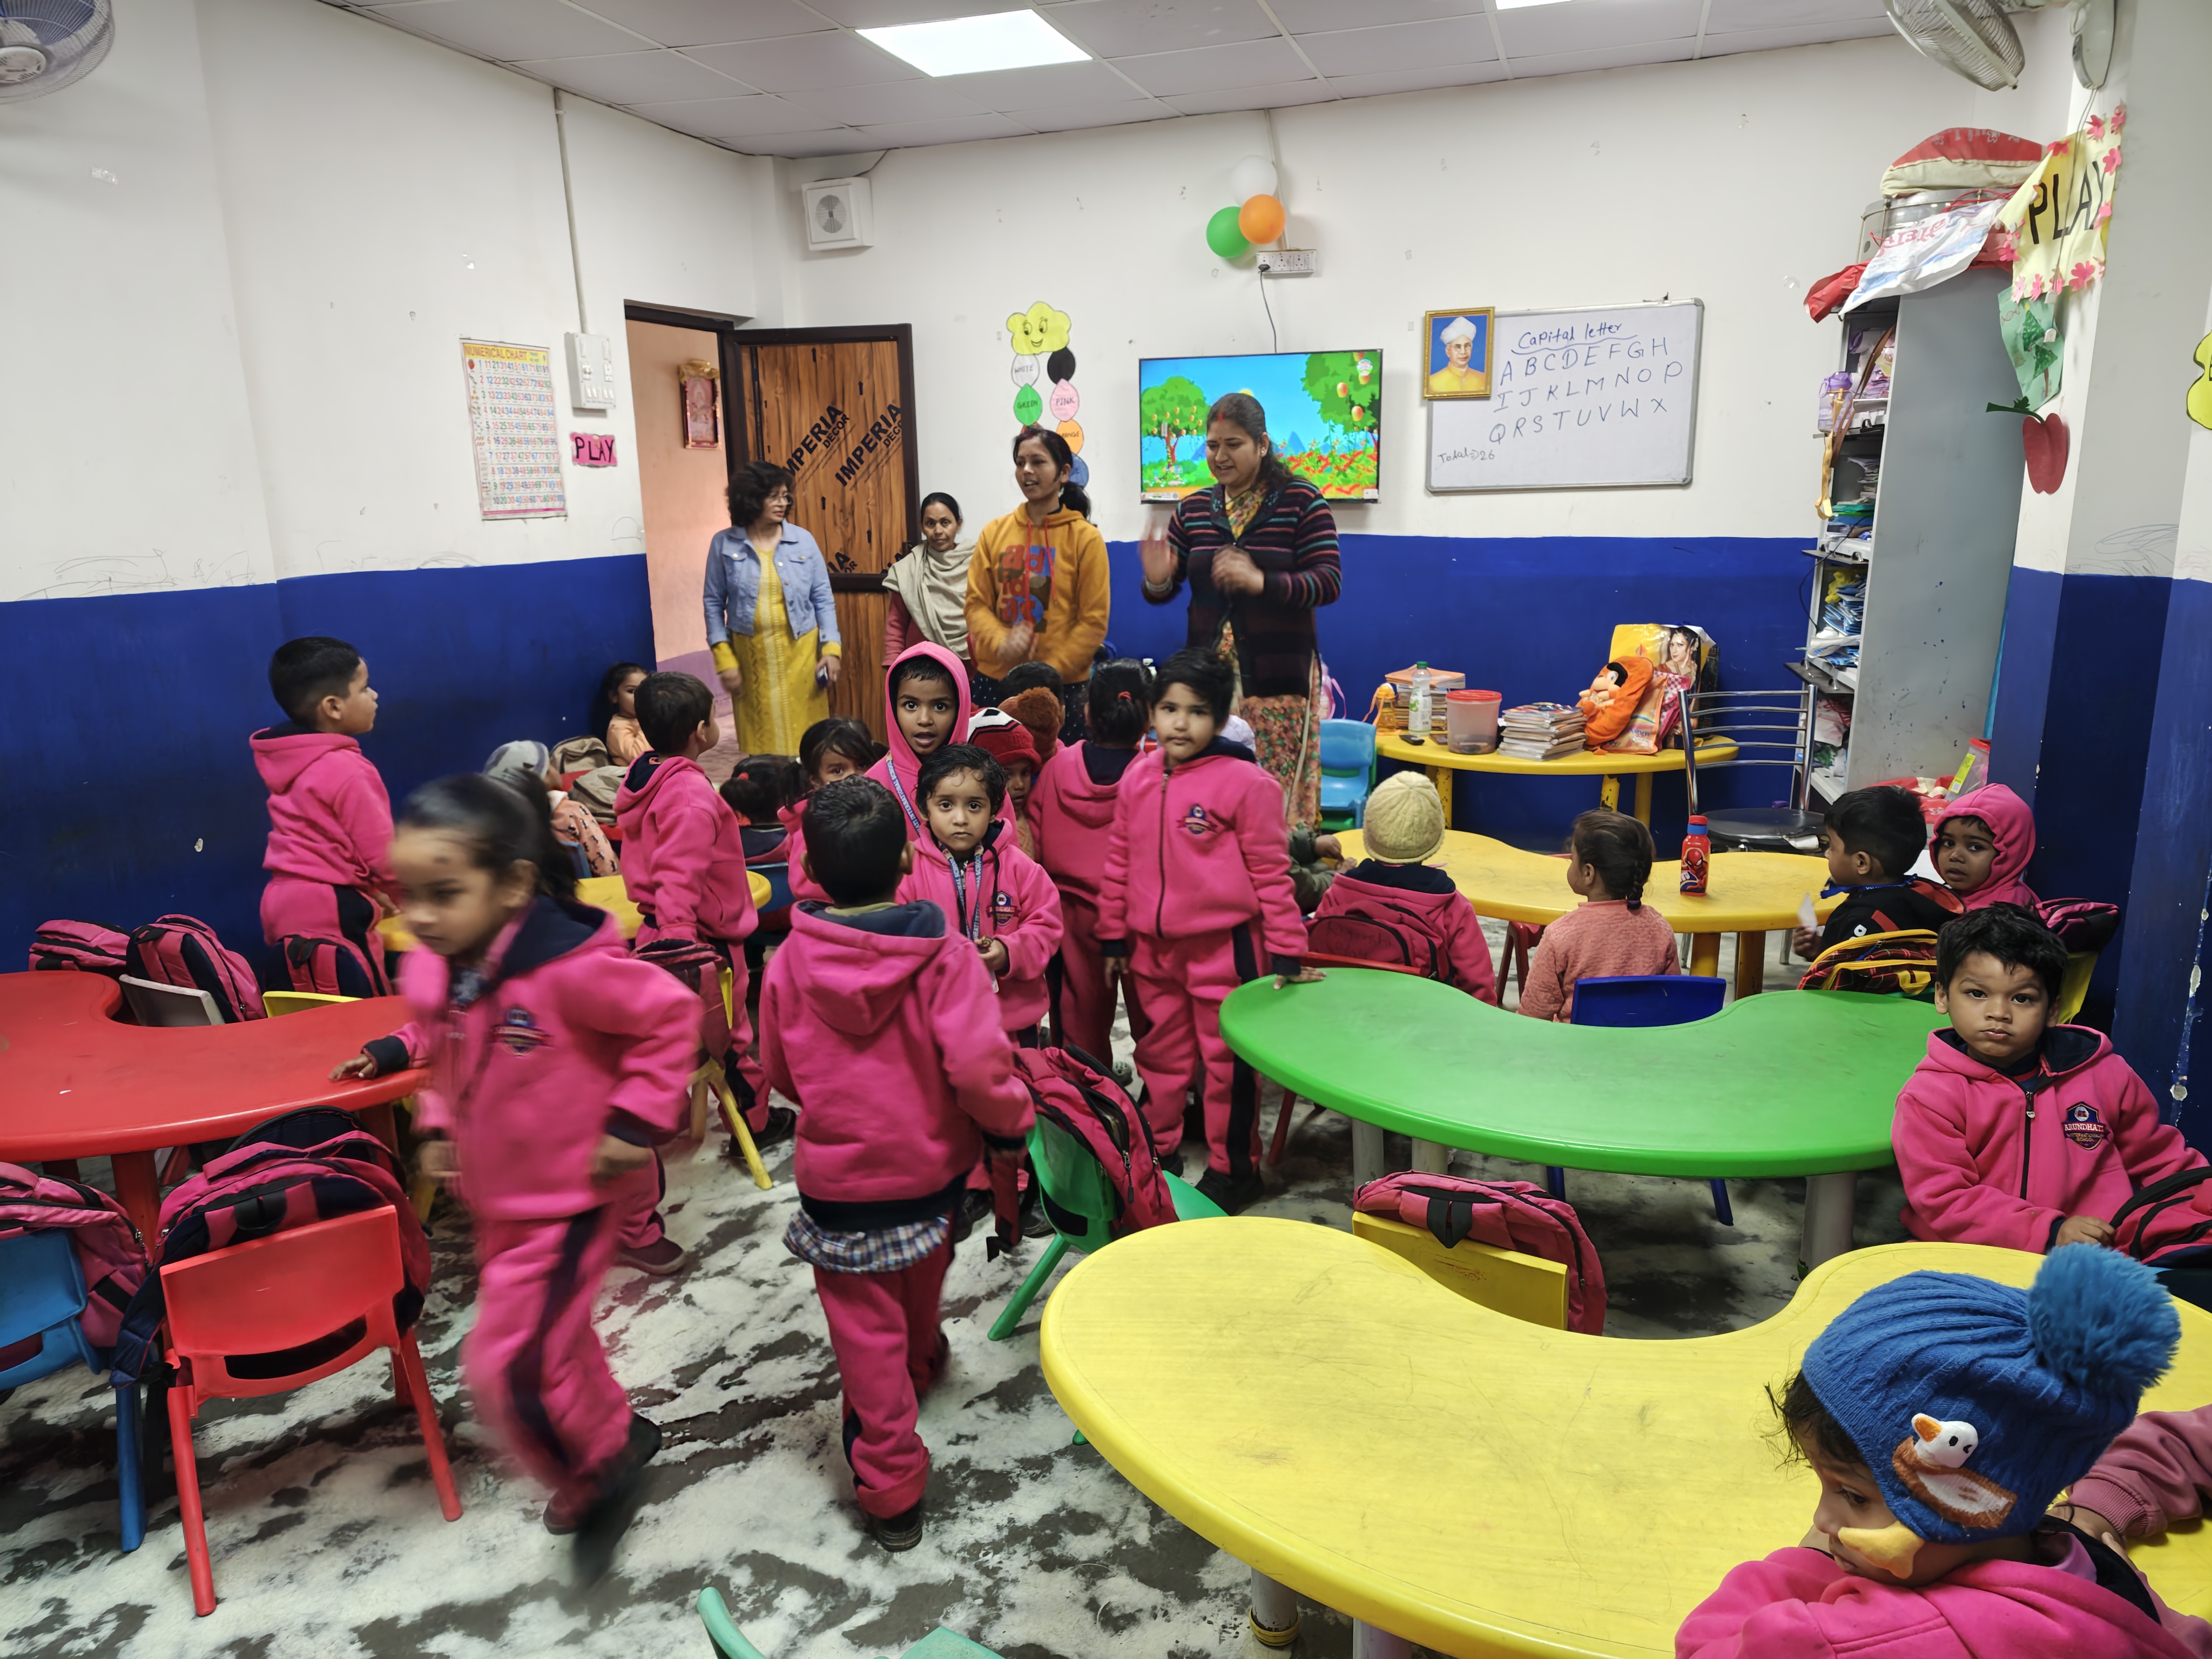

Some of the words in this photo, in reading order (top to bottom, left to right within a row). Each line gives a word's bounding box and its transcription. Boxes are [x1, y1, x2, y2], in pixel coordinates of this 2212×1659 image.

[2028, 161, 2106, 245] PLAY
[1518, 326, 1575, 349] Capital
[1585, 323, 1622, 338] letter
[464, 346, 505, 359] NUMERICAL
[505, 349, 527, 361] CHART
[1500, 361, 1513, 386] A
[1525, 358, 1537, 377] B
[1544, 353, 1556, 371] C
[1562, 348, 1578, 370] D
[1584, 346, 1601, 367] E
[1609, 343, 1622, 360] F
[1628, 341, 1644, 359] G
[1651, 336, 1668, 357] H
[492, 361, 499, 369] 21
[1014, 364, 1034, 374] WHITE
[480, 375, 483, 383] 2
[486, 376, 493, 384] 12
[494, 376, 501, 385] 22
[1493, 390, 1513, 413] I
[1520, 387, 1539, 408] J
[1547, 385, 1559, 402] K
[1566, 381, 1580, 396] L
[1586, 377, 1605, 395] M
[1615, 367, 1629, 388] N
[1637, 368, 1651, 382] O
[1665, 361, 1683, 383] P
[481, 390, 485, 399] 3
[1016, 400, 1038, 409] GREEN
[1056, 397, 1075, 406] PINK
[1489, 423, 1506, 444] Q
[1513, 417, 1527, 438] R
[1533, 415, 1543, 433] S
[1553, 410, 1570, 430] T
[1577, 409, 1592, 427] U
[1599, 403, 1611, 422] V
[1621, 398, 1638, 417] W
[1651, 397, 1667, 413] X
[783, 406, 844, 476] MPERIA
[822, 414, 849, 448] DECOR
[1059, 430, 1080, 439] RANGE
[575, 436, 614, 463] PLAY
[835, 404, 901, 486] IMPERIA
[1437, 447, 1469, 463] Total
[1480, 449, 1495, 460] 26
[887, 760, 896, 780] SCHOOL
[893, 779, 916, 820] INTERNATIONAL
[949, 858, 960, 878] SCHOOL
